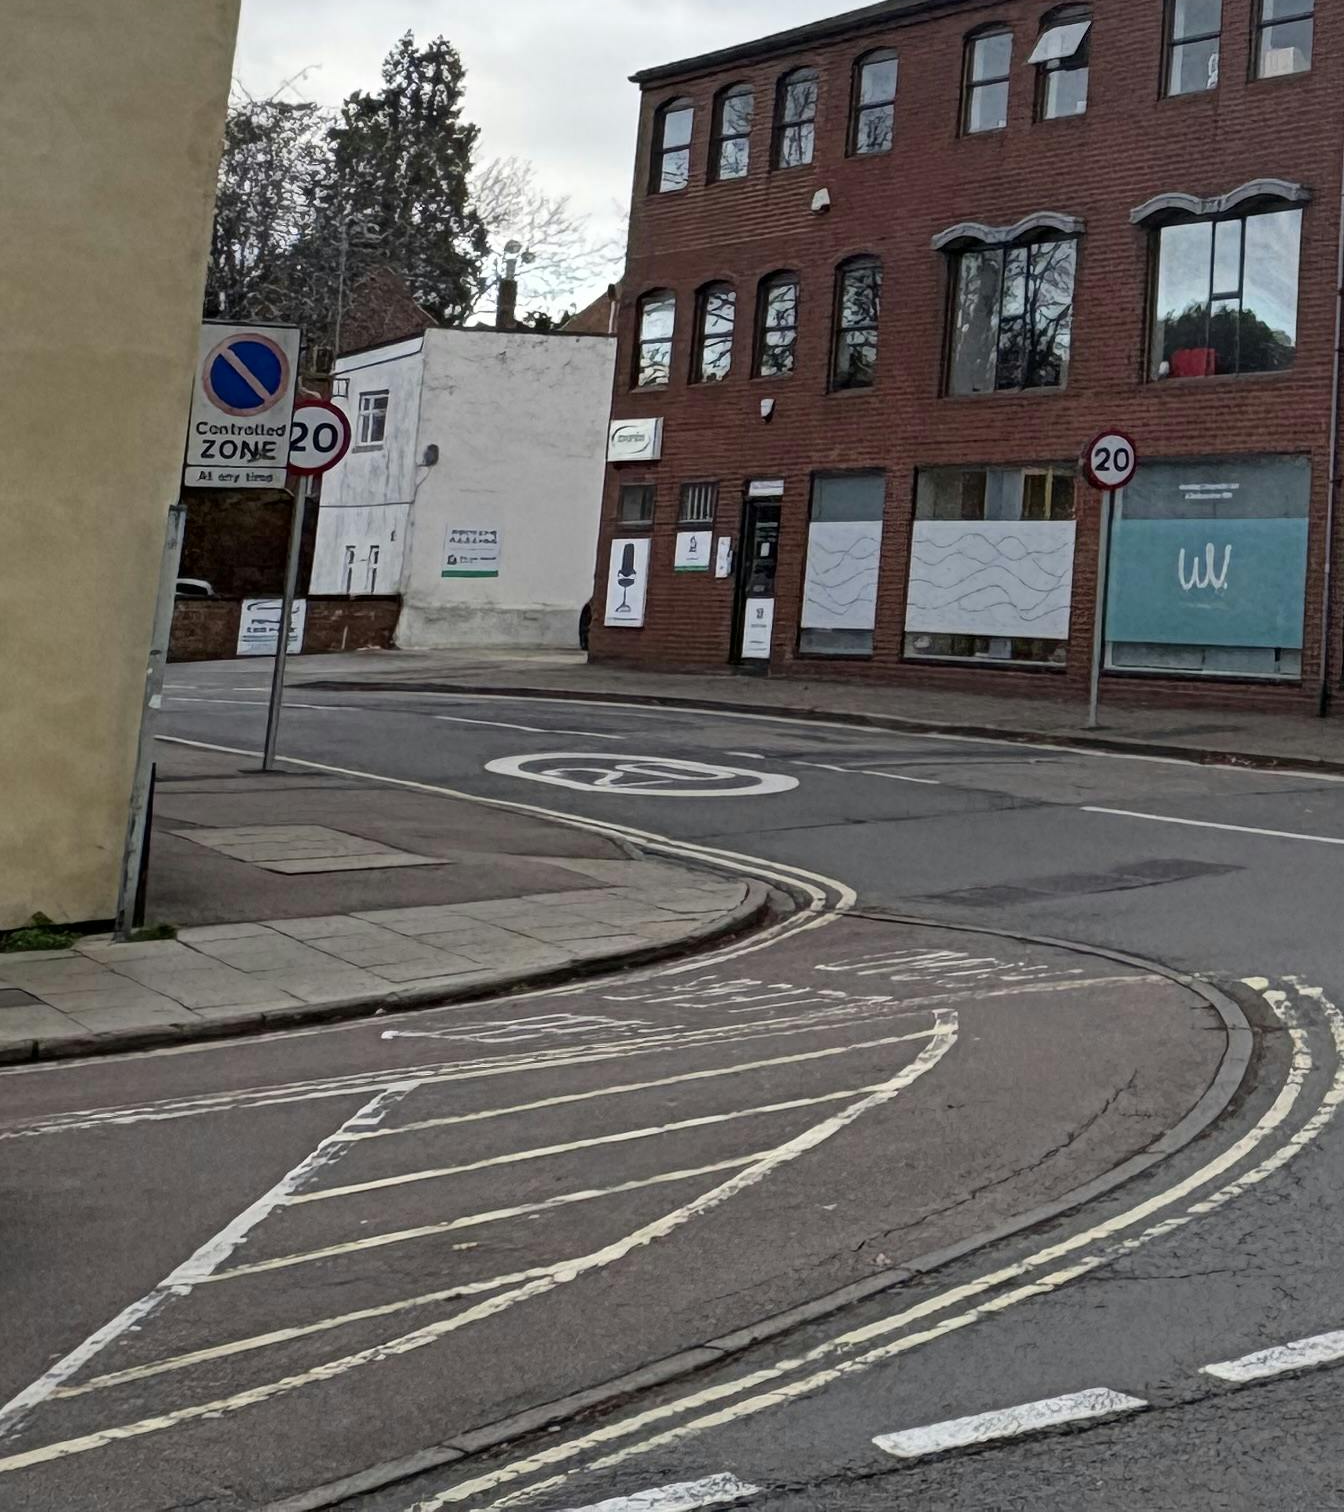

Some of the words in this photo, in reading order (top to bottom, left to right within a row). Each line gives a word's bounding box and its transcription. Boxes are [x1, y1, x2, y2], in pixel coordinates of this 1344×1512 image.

[196, 421, 287, 437] Controlled
[291, 422, 338, 453] 20
[200, 439, 277, 461] ZONE
[1095, 447, 1129, 472] 20
